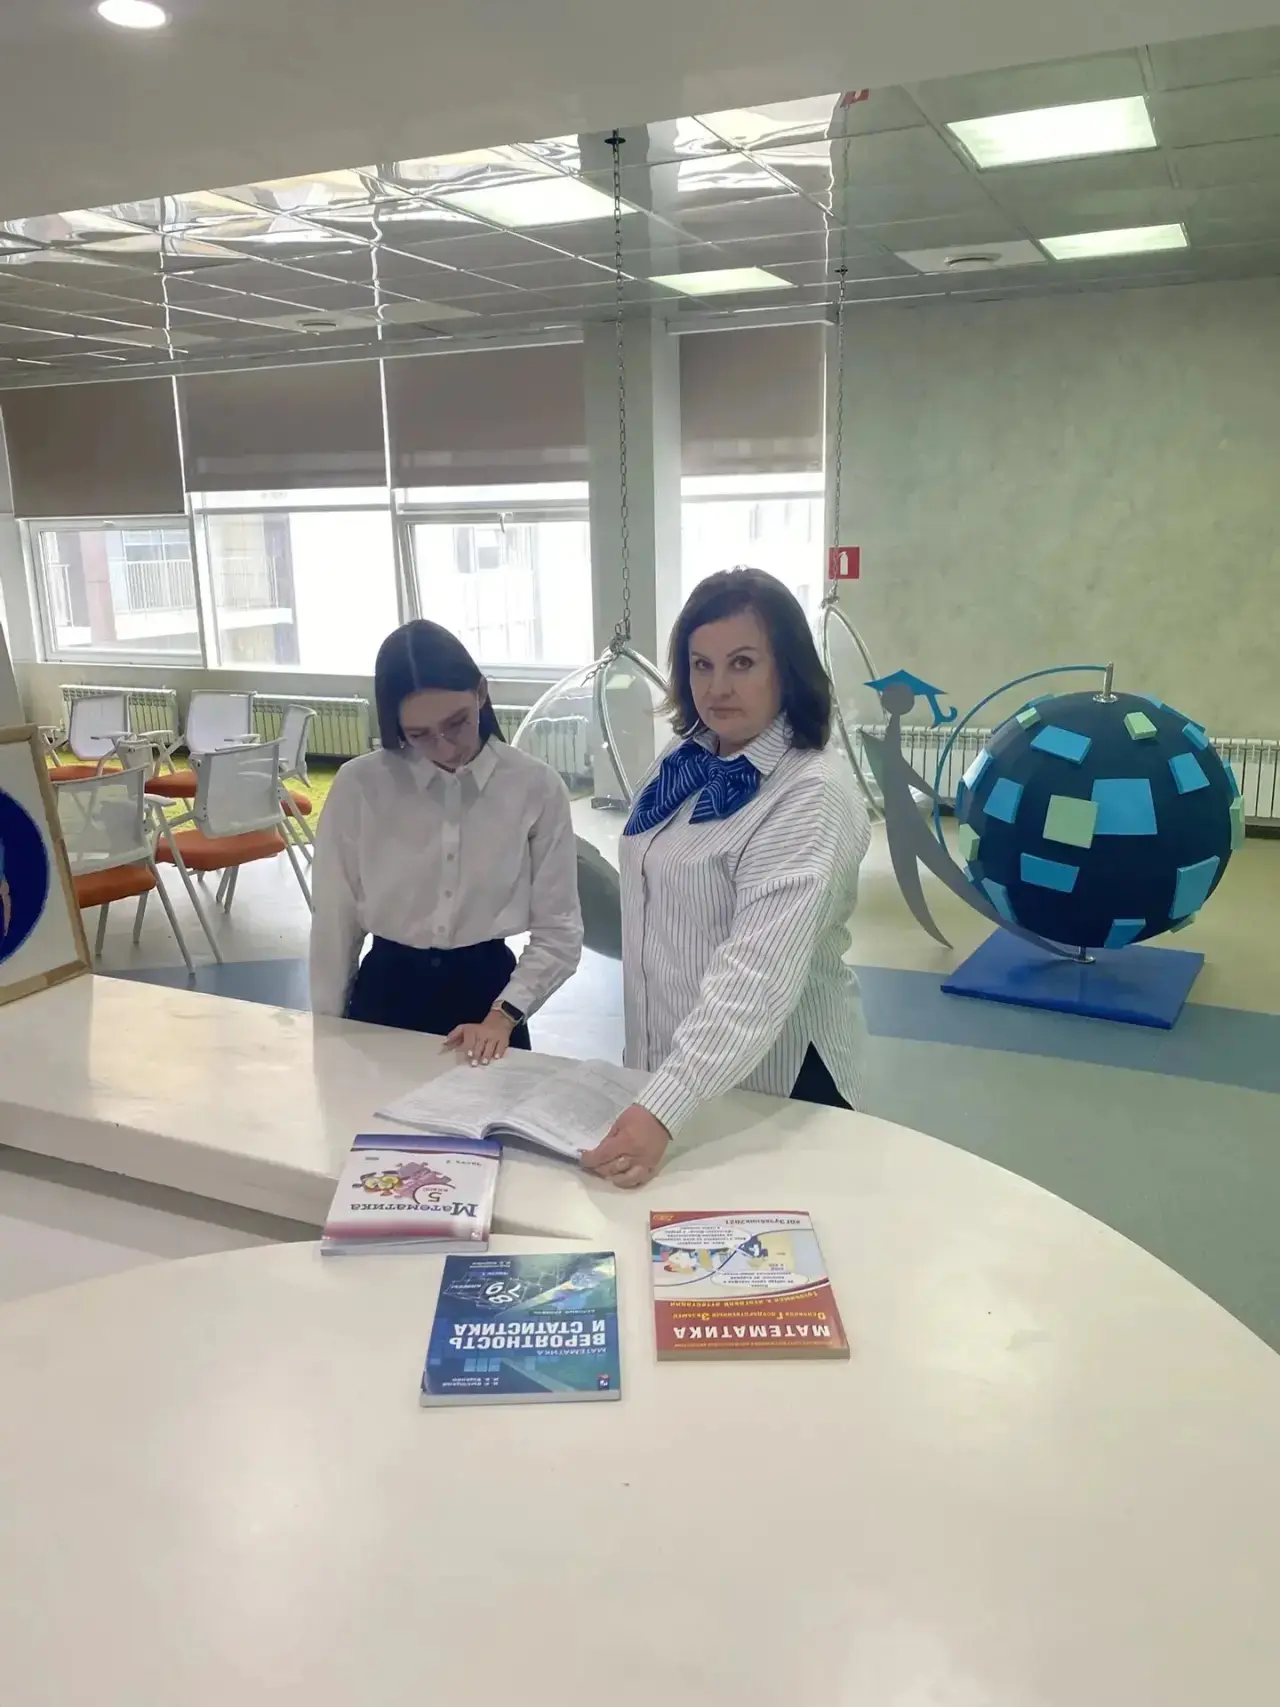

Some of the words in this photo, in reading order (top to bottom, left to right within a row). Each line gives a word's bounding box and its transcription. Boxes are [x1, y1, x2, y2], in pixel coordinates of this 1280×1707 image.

[428, 1192, 442, 1203] 5
[350, 1202, 478, 1218] Математика
[485, 1281, 504, 1295] 9
[508, 1283, 521, 1298] 7
[488, 1294, 513, 1304] 8
[454, 1321, 583, 1336] СТАТИСТИКА
[592, 1319, 606, 1332] И
[673, 1324, 831, 1339] МАТЕМАТИКА
[449, 1333, 606, 1349] ВЕРОЯТНОСТЬ
[537, 1347, 606, 1356] МАТЕМАТИКА
